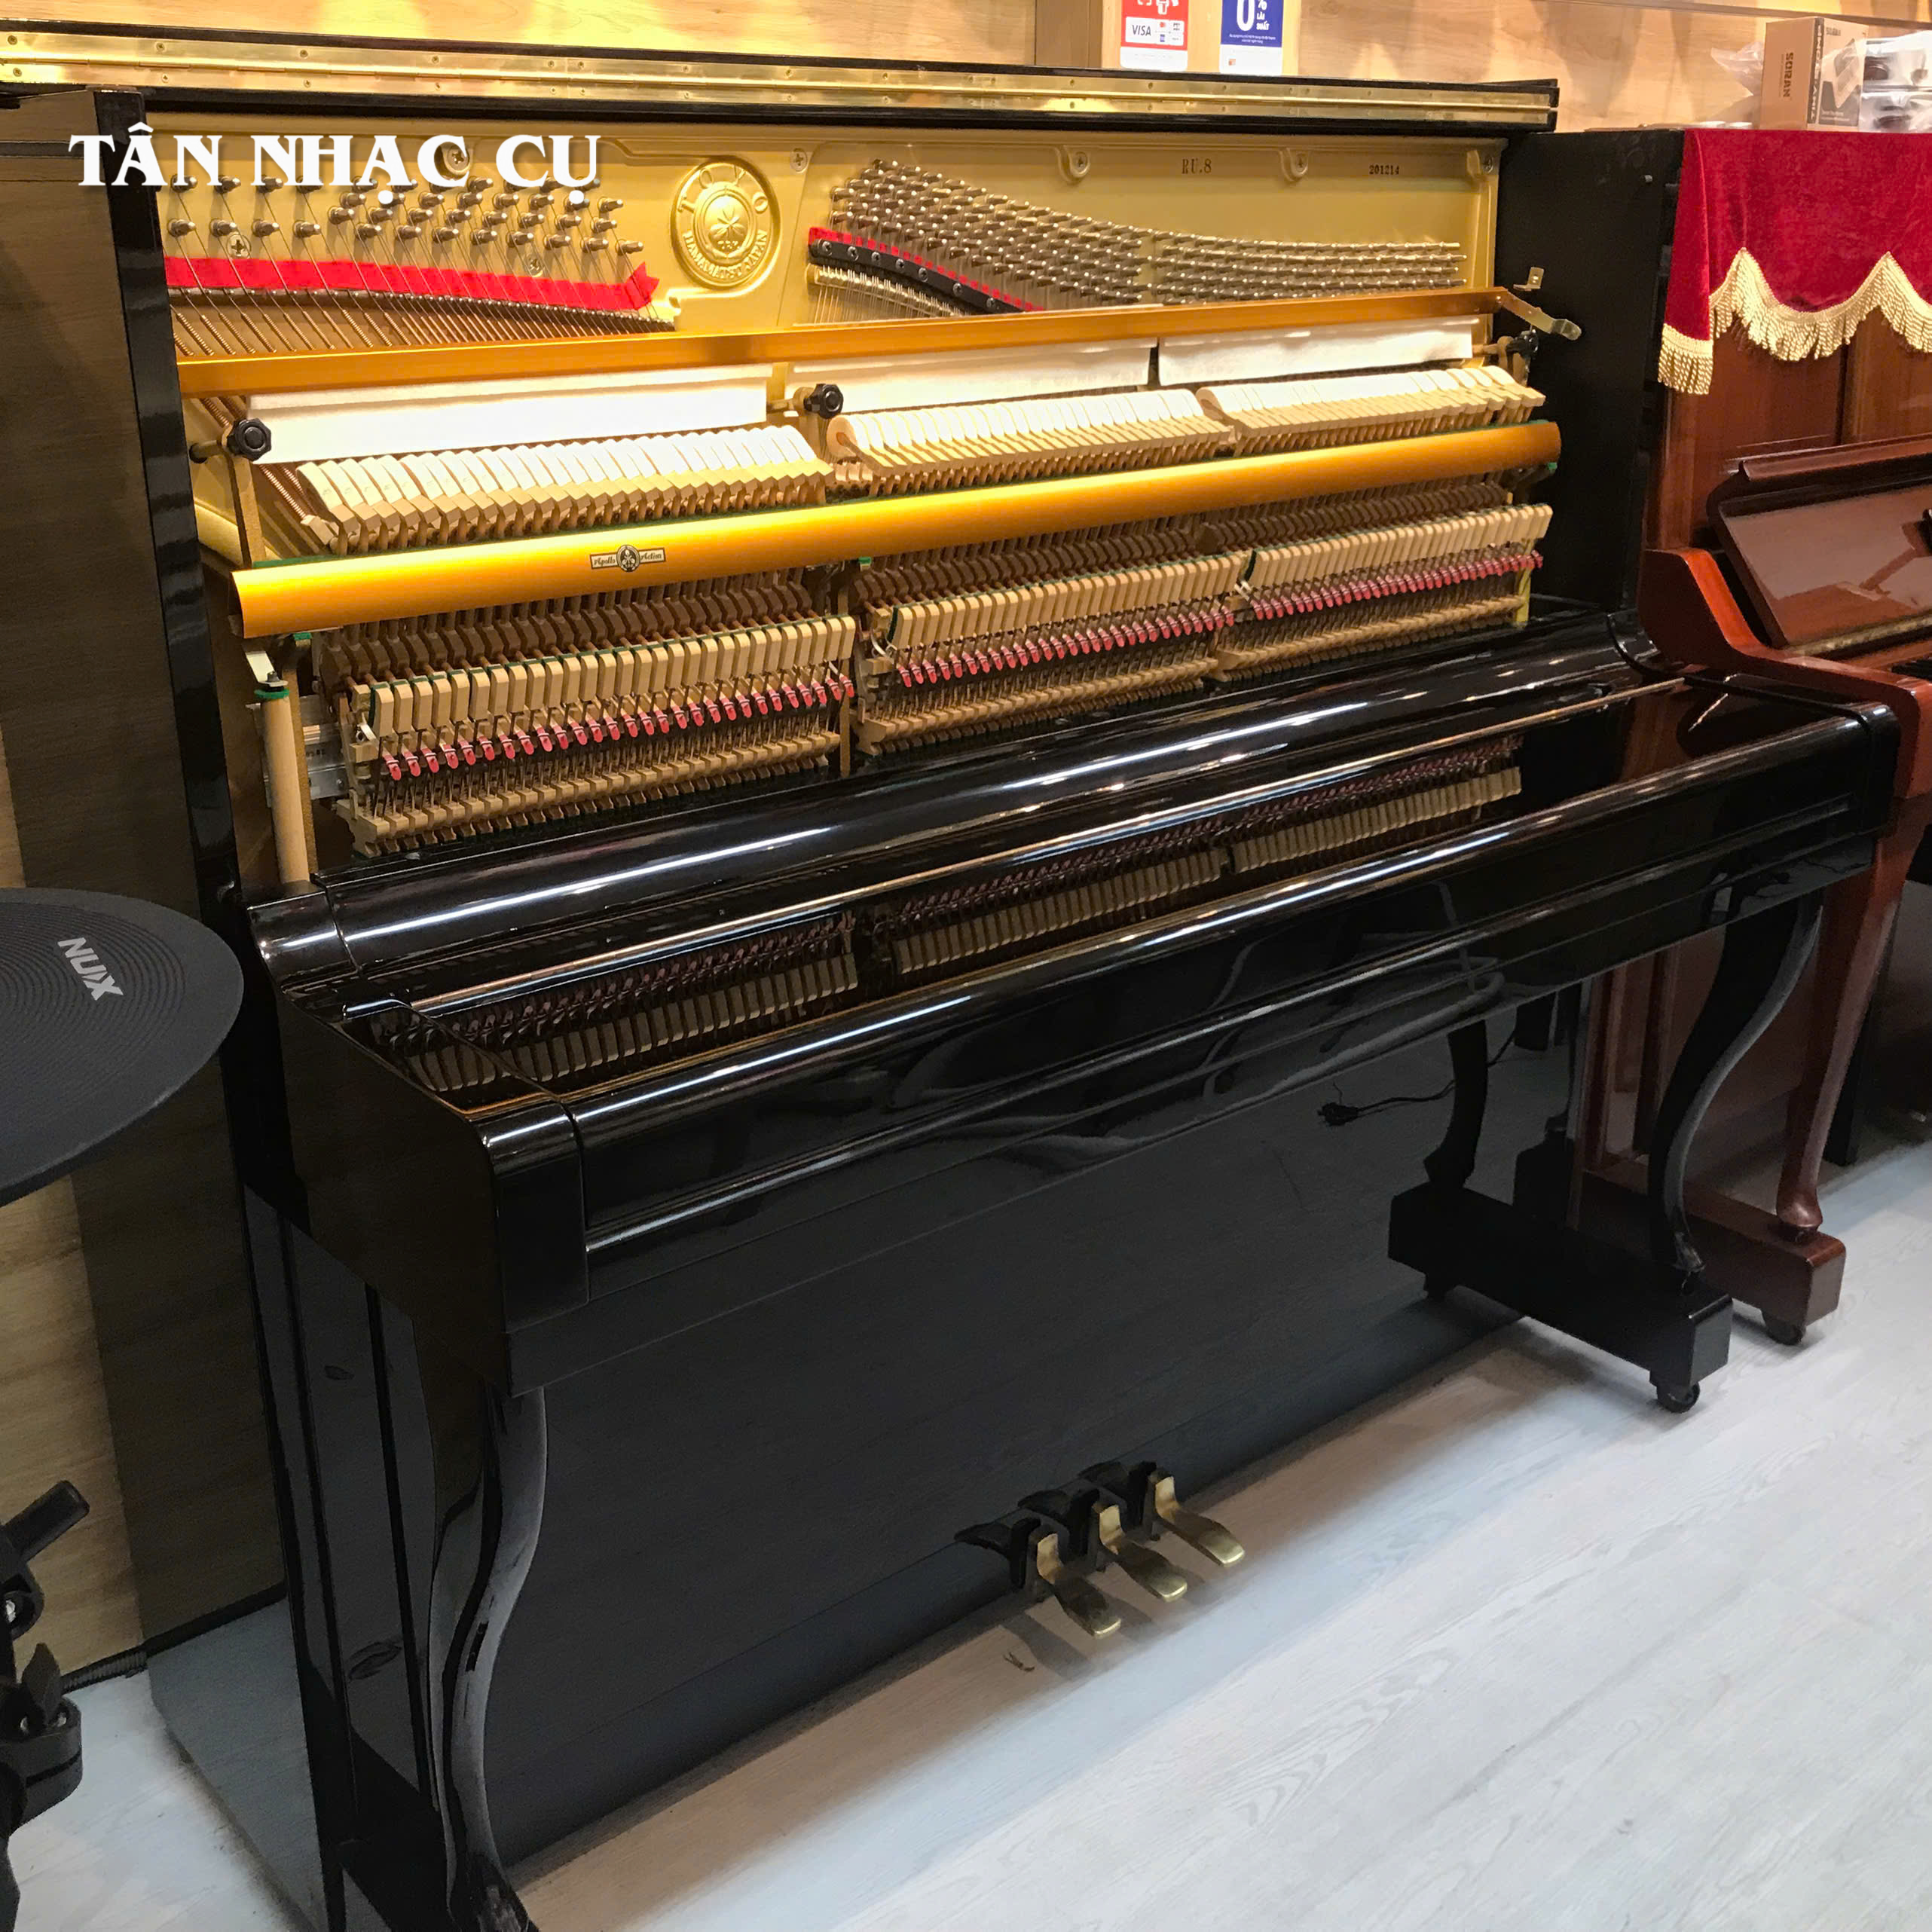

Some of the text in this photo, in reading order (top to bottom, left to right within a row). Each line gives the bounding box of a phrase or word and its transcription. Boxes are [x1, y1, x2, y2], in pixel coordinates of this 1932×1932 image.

[1132, 24, 1151, 36] VISA
[1783, 52, 1793, 98] SORAN
[1181, 158, 1212, 175] RU.8
[1368, 164, 1400, 176] 201214
[677, 164, 769, 215] TOYO
[594, 552, 662, 567] Apollo Action
[57, 937, 124, 1001] NUX
